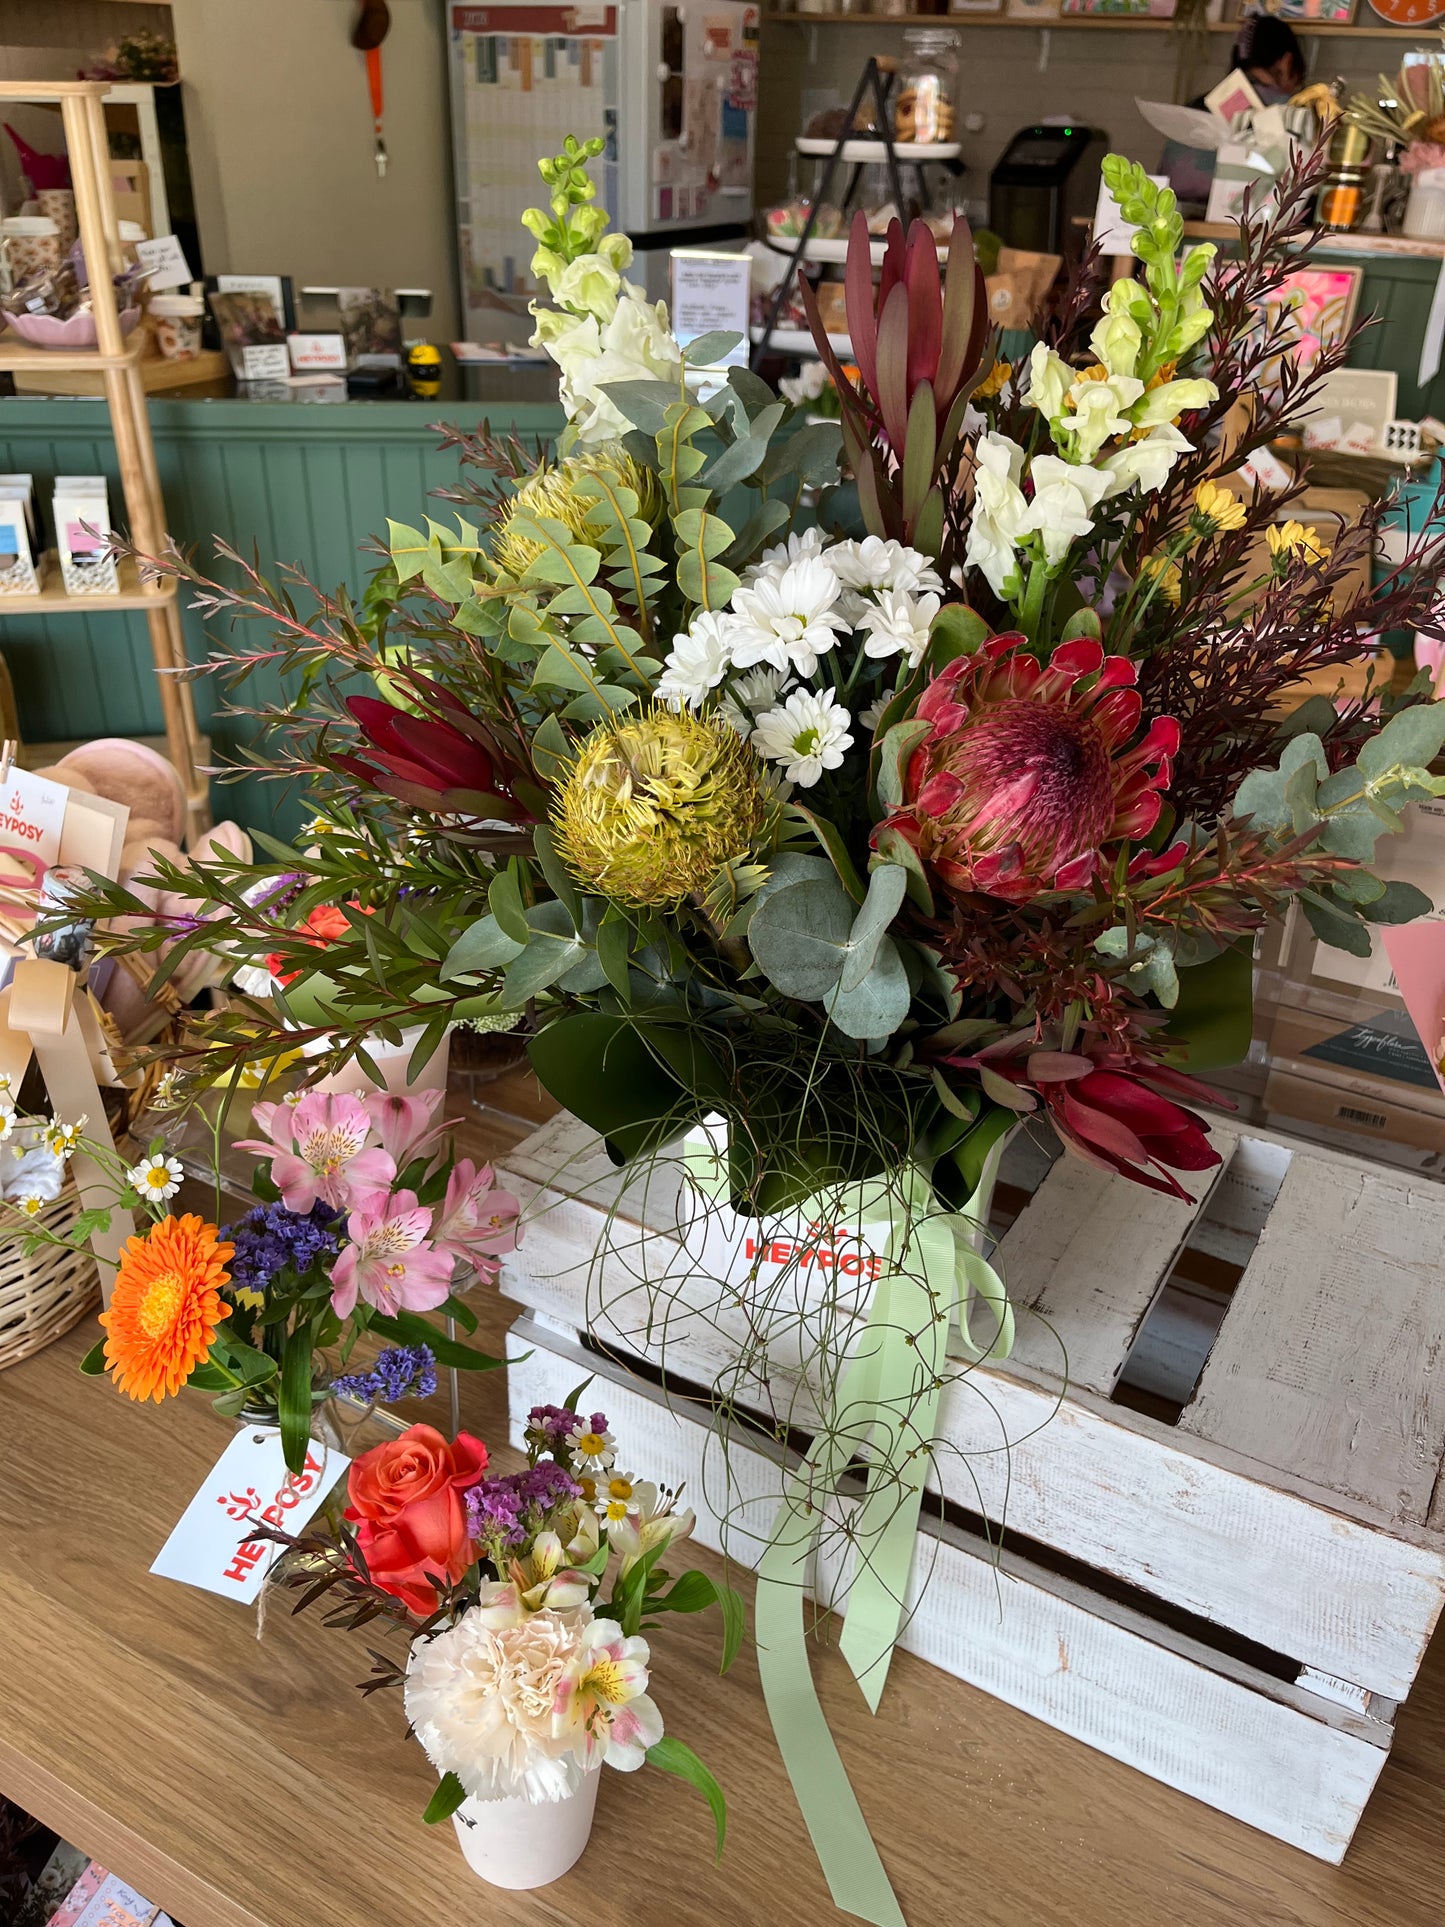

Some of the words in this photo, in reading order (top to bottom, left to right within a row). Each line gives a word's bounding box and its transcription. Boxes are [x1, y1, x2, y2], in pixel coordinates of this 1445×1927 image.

[1407, 4, 1417, 18] 6
[0, 812, 44, 842] EYPOSY
[745, 1238, 883, 1280] HEYPOS
[222, 1451, 324, 1583] HEPOSY
